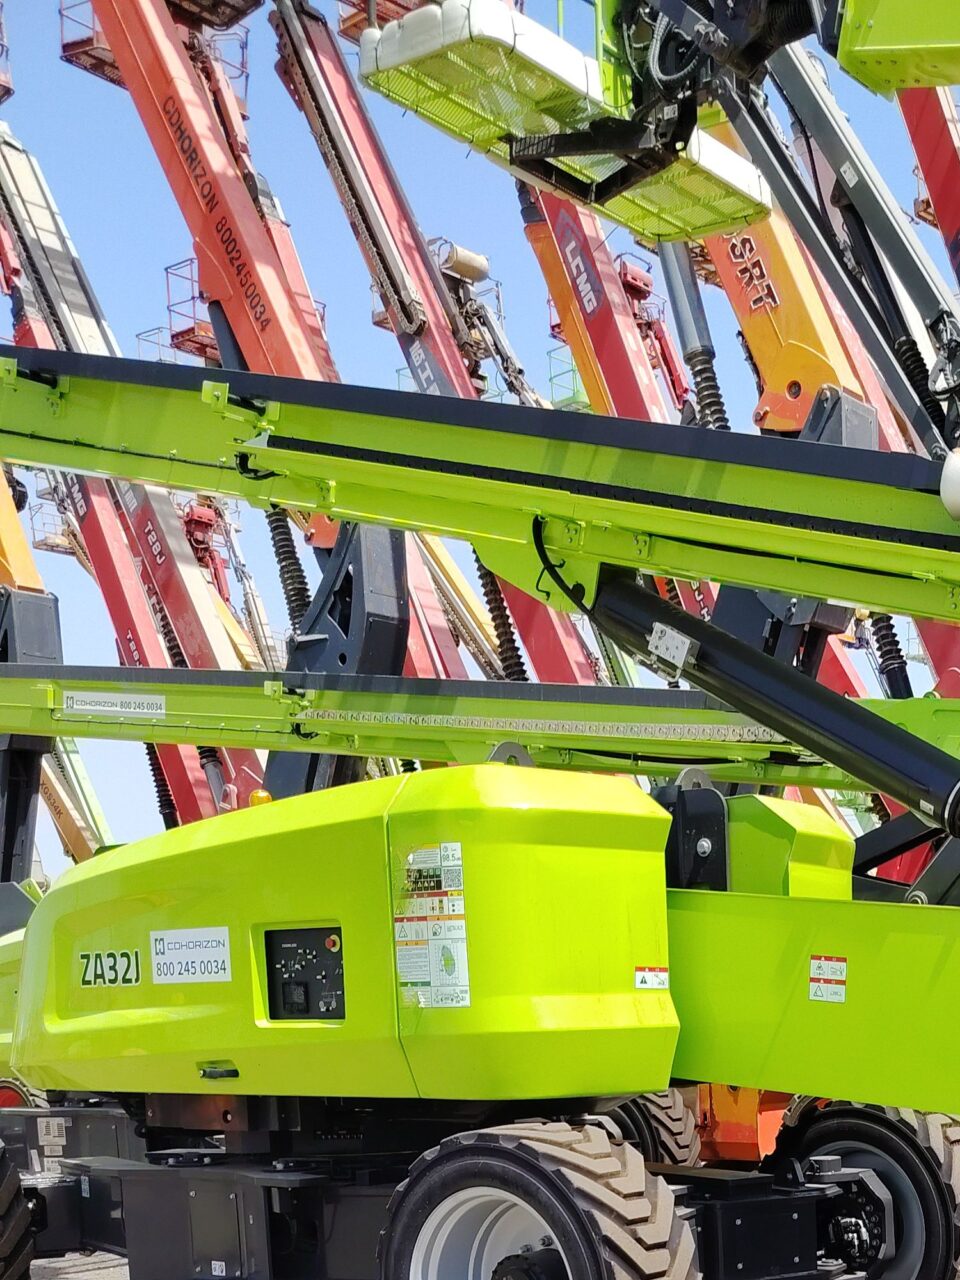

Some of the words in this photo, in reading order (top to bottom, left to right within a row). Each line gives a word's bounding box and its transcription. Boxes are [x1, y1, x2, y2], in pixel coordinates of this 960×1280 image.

[163, 96, 219, 214] CDHORIZON
[215, 215, 272, 333] 8002450034
[723, 231, 780, 309] SRT
[142, 518, 166, 566] T28J
[119, 700, 132, 710] 800
[133, 701, 146, 711] 245
[146, 702, 163, 711] 0034
[80, 950, 141, 986] ZA32J
[156, 961, 175, 977] 800
[177, 960, 197, 976] 245
[200, 959, 227, 975] 0034
